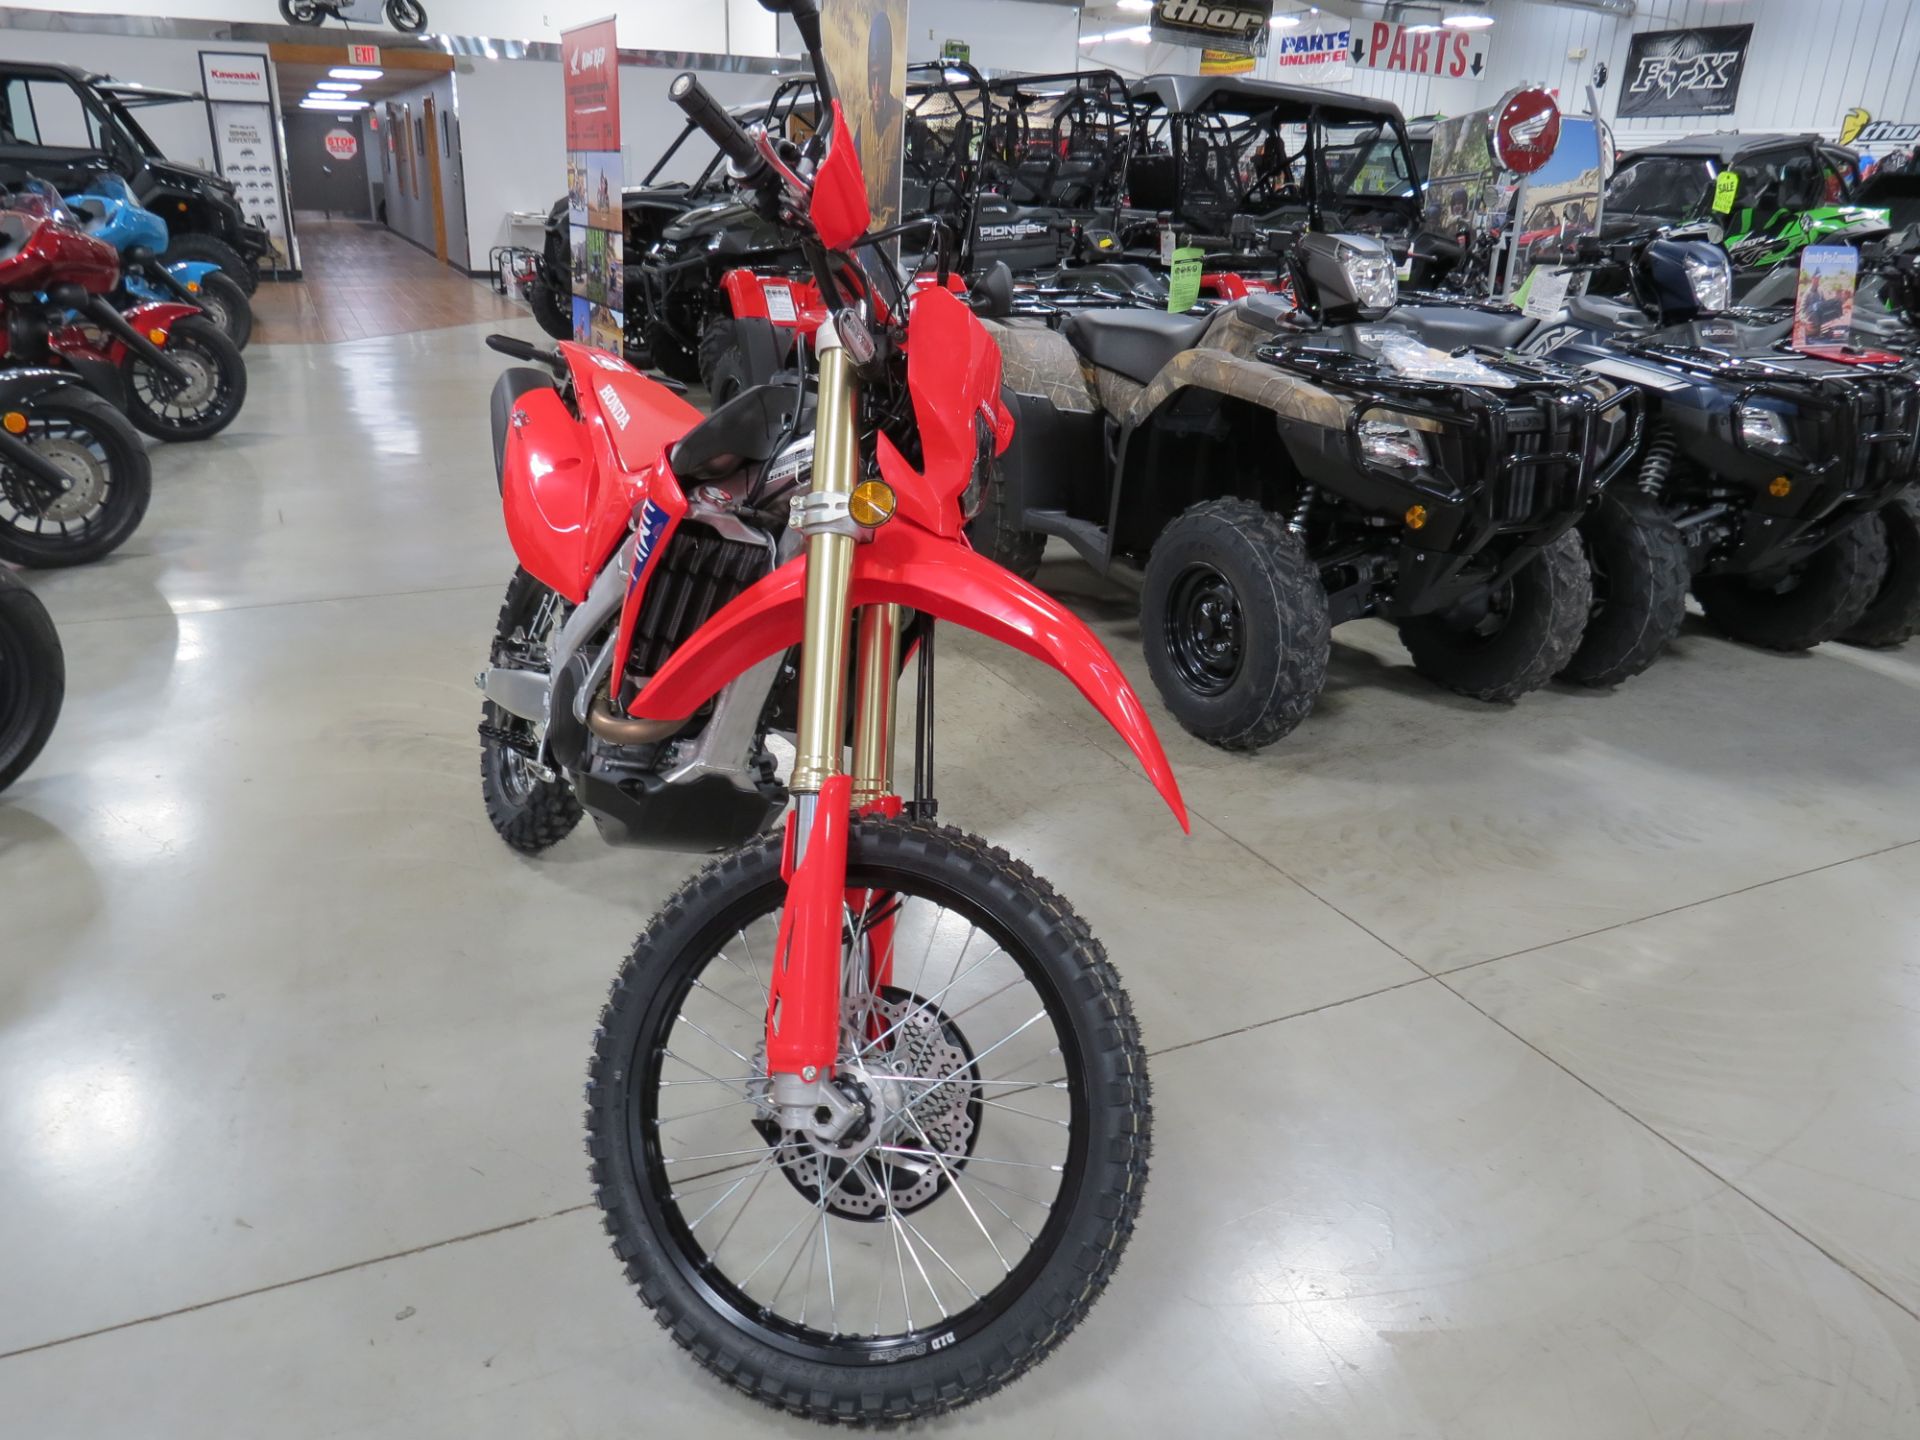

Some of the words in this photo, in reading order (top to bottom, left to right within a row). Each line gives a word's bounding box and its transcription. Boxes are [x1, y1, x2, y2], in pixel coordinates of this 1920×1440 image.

[1160, 0, 1266, 31] thor
[1280, 30, 1350, 54] PARTS
[1368, 21, 1470, 78] PARTS
[353, 46, 376, 64] EXIT
[211, 69, 261, 81] Kawasaki
[327, 136, 355, 147] STOP
[1717, 181, 1735, 194] SALE
[599, 383, 631, 431] HONDA
